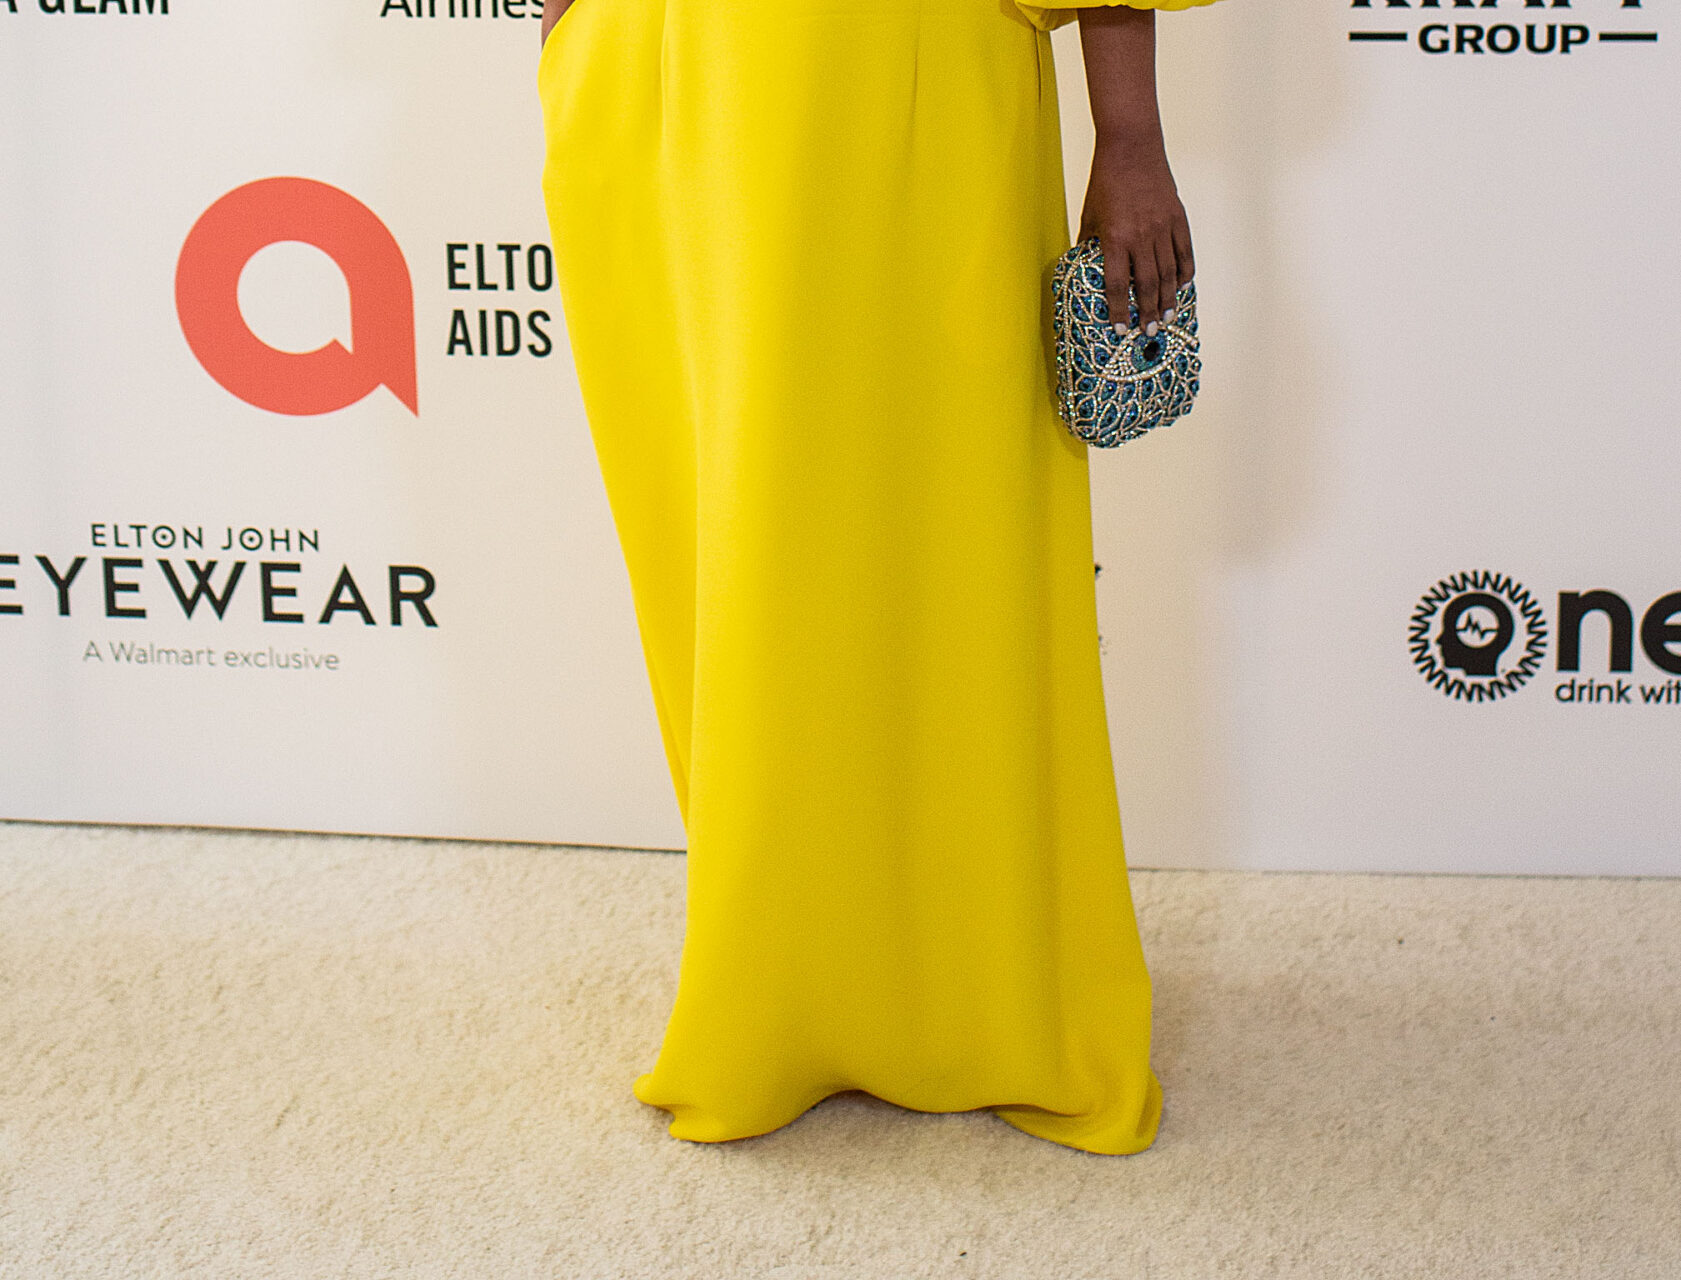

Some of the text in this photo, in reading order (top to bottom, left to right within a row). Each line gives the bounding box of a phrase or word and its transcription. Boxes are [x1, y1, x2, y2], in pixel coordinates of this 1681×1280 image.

[1419, 24, 1589, 55] GROUP
[446, 309, 552, 358] AIDS
[91, 524, 319, 552] ELTON JOHN
[0, 554, 439, 628] EYEWEAR
[83, 642, 339, 671] A Walmart exclusive
[1555, 678, 1632, 704] drink
